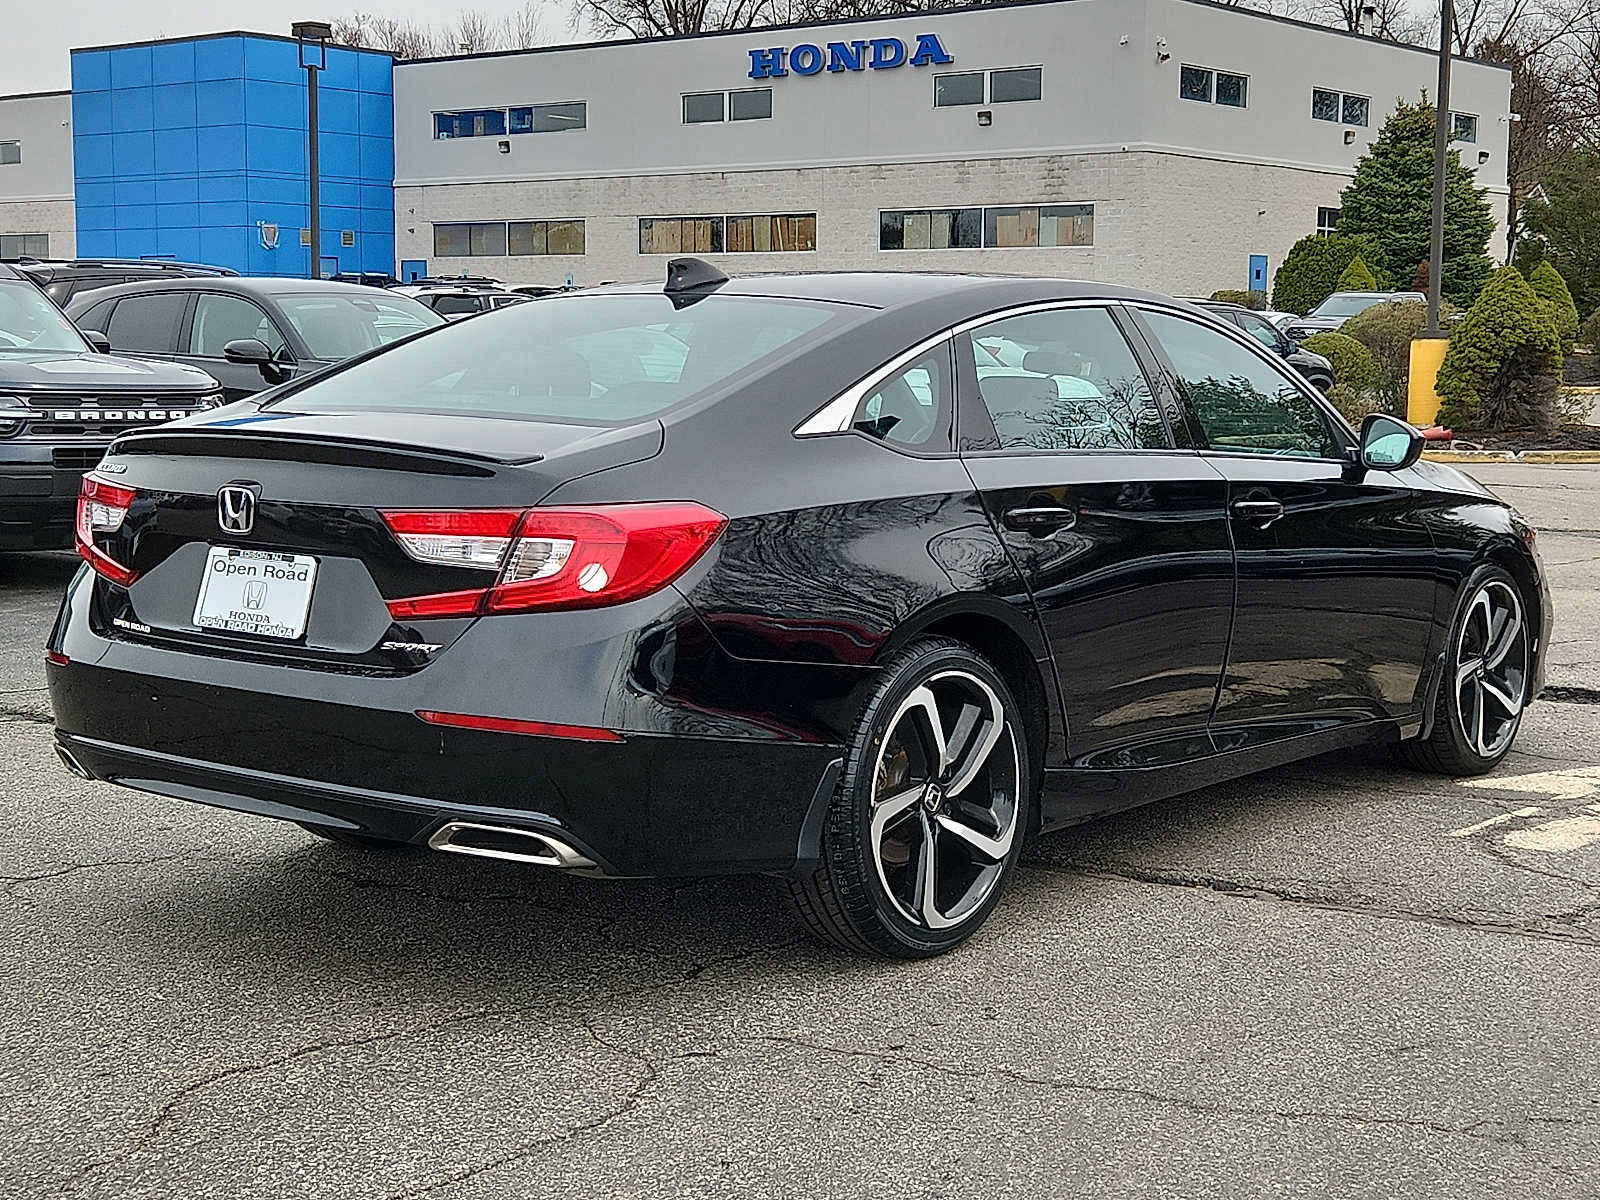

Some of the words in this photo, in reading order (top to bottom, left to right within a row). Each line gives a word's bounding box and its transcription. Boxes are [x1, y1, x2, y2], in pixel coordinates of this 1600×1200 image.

[748, 33, 954, 79] HONDA
[54, 410, 186, 420] BRONCO
[213, 559, 257, 577] Open
[263, 564, 309, 582] Road
[228, 610, 270, 624] HONDA
[131, 622, 151, 633] ROAD
[198, 616, 226, 629] OPEN
[227, 620, 256, 632] ROAD
[257, 624, 294, 638] HONDA
[380, 641, 443, 654] SPORT
